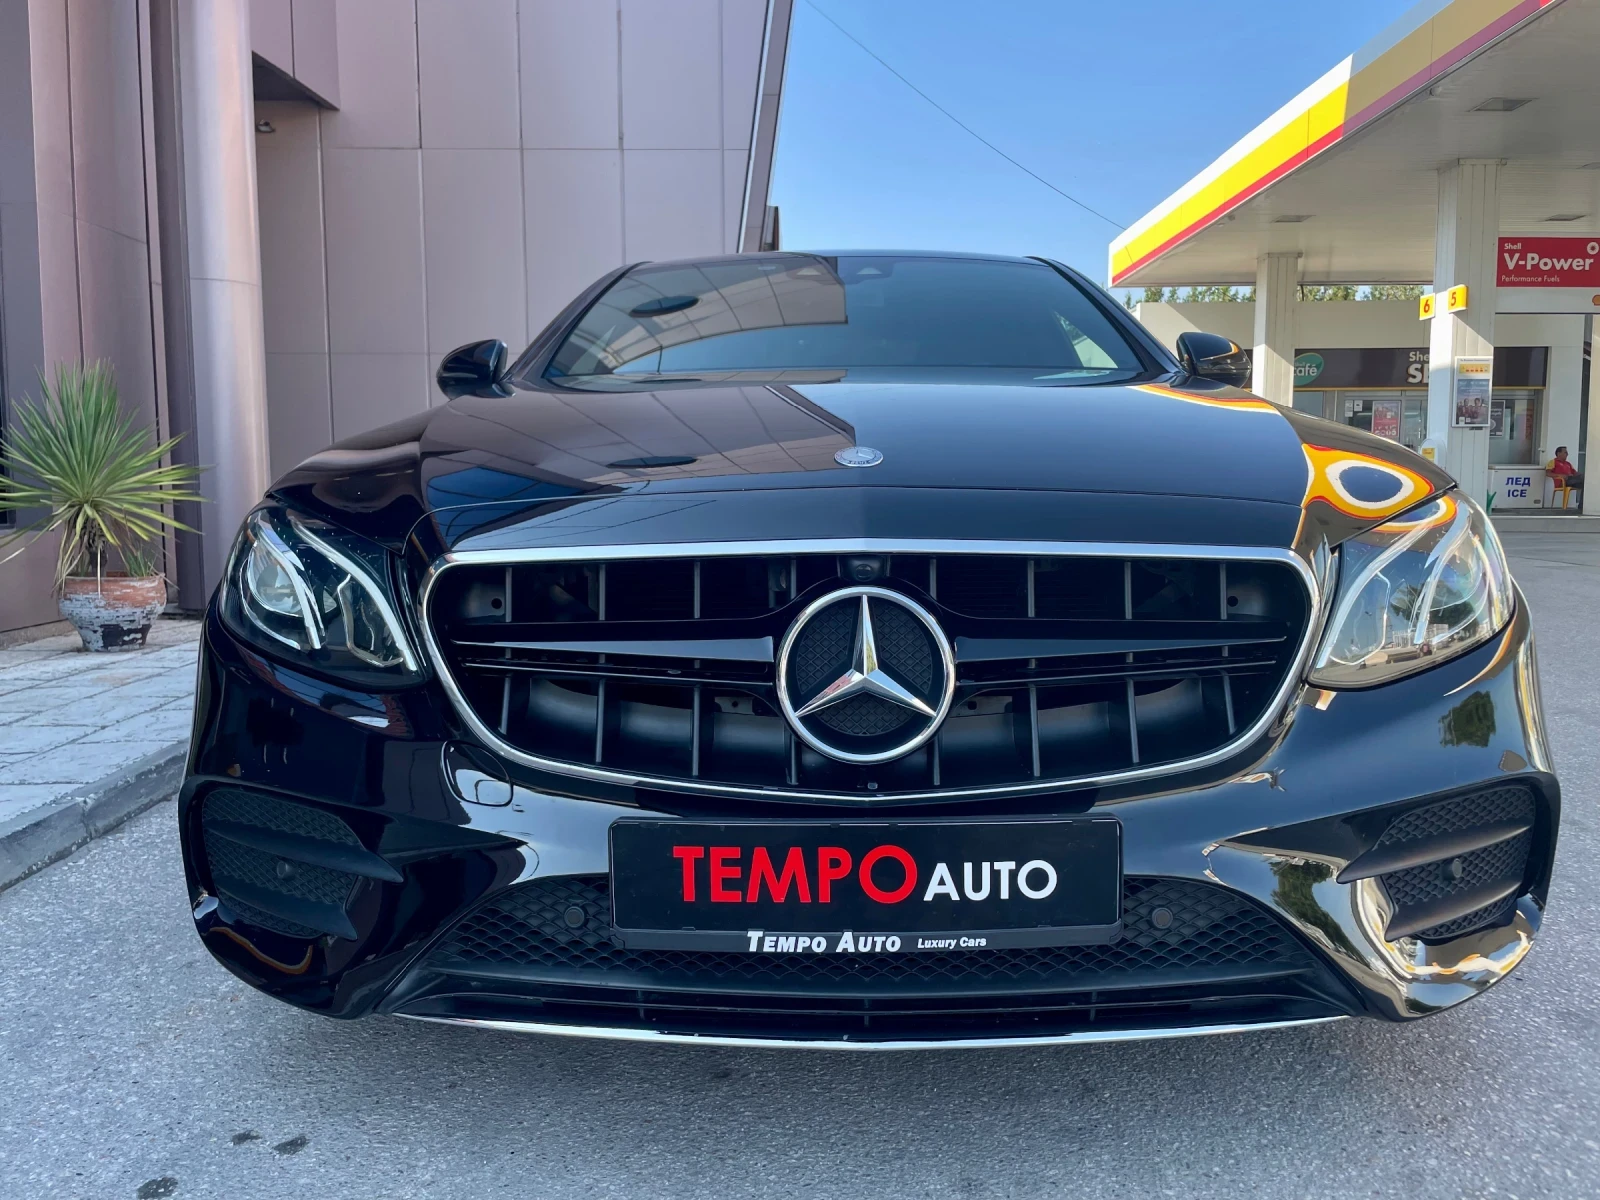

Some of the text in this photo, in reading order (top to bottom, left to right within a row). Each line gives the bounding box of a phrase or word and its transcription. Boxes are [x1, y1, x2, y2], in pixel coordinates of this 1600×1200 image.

[1503, 252, 1594, 271] V-Power
[1501, 275, 1560, 283] Performance Fuels
[1450, 291, 1457, 307] 5
[1423, 299, 1430, 314] 6
[1409, 351, 1430, 361] She
[1505, 476, 1531, 487] ЛЕД
[1507, 489, 1527, 498] ICE
[672, 844, 1058, 904] TEMPO AUTO
[917, 938, 957, 950] Luxury
[959, 936, 987, 948] Cars
